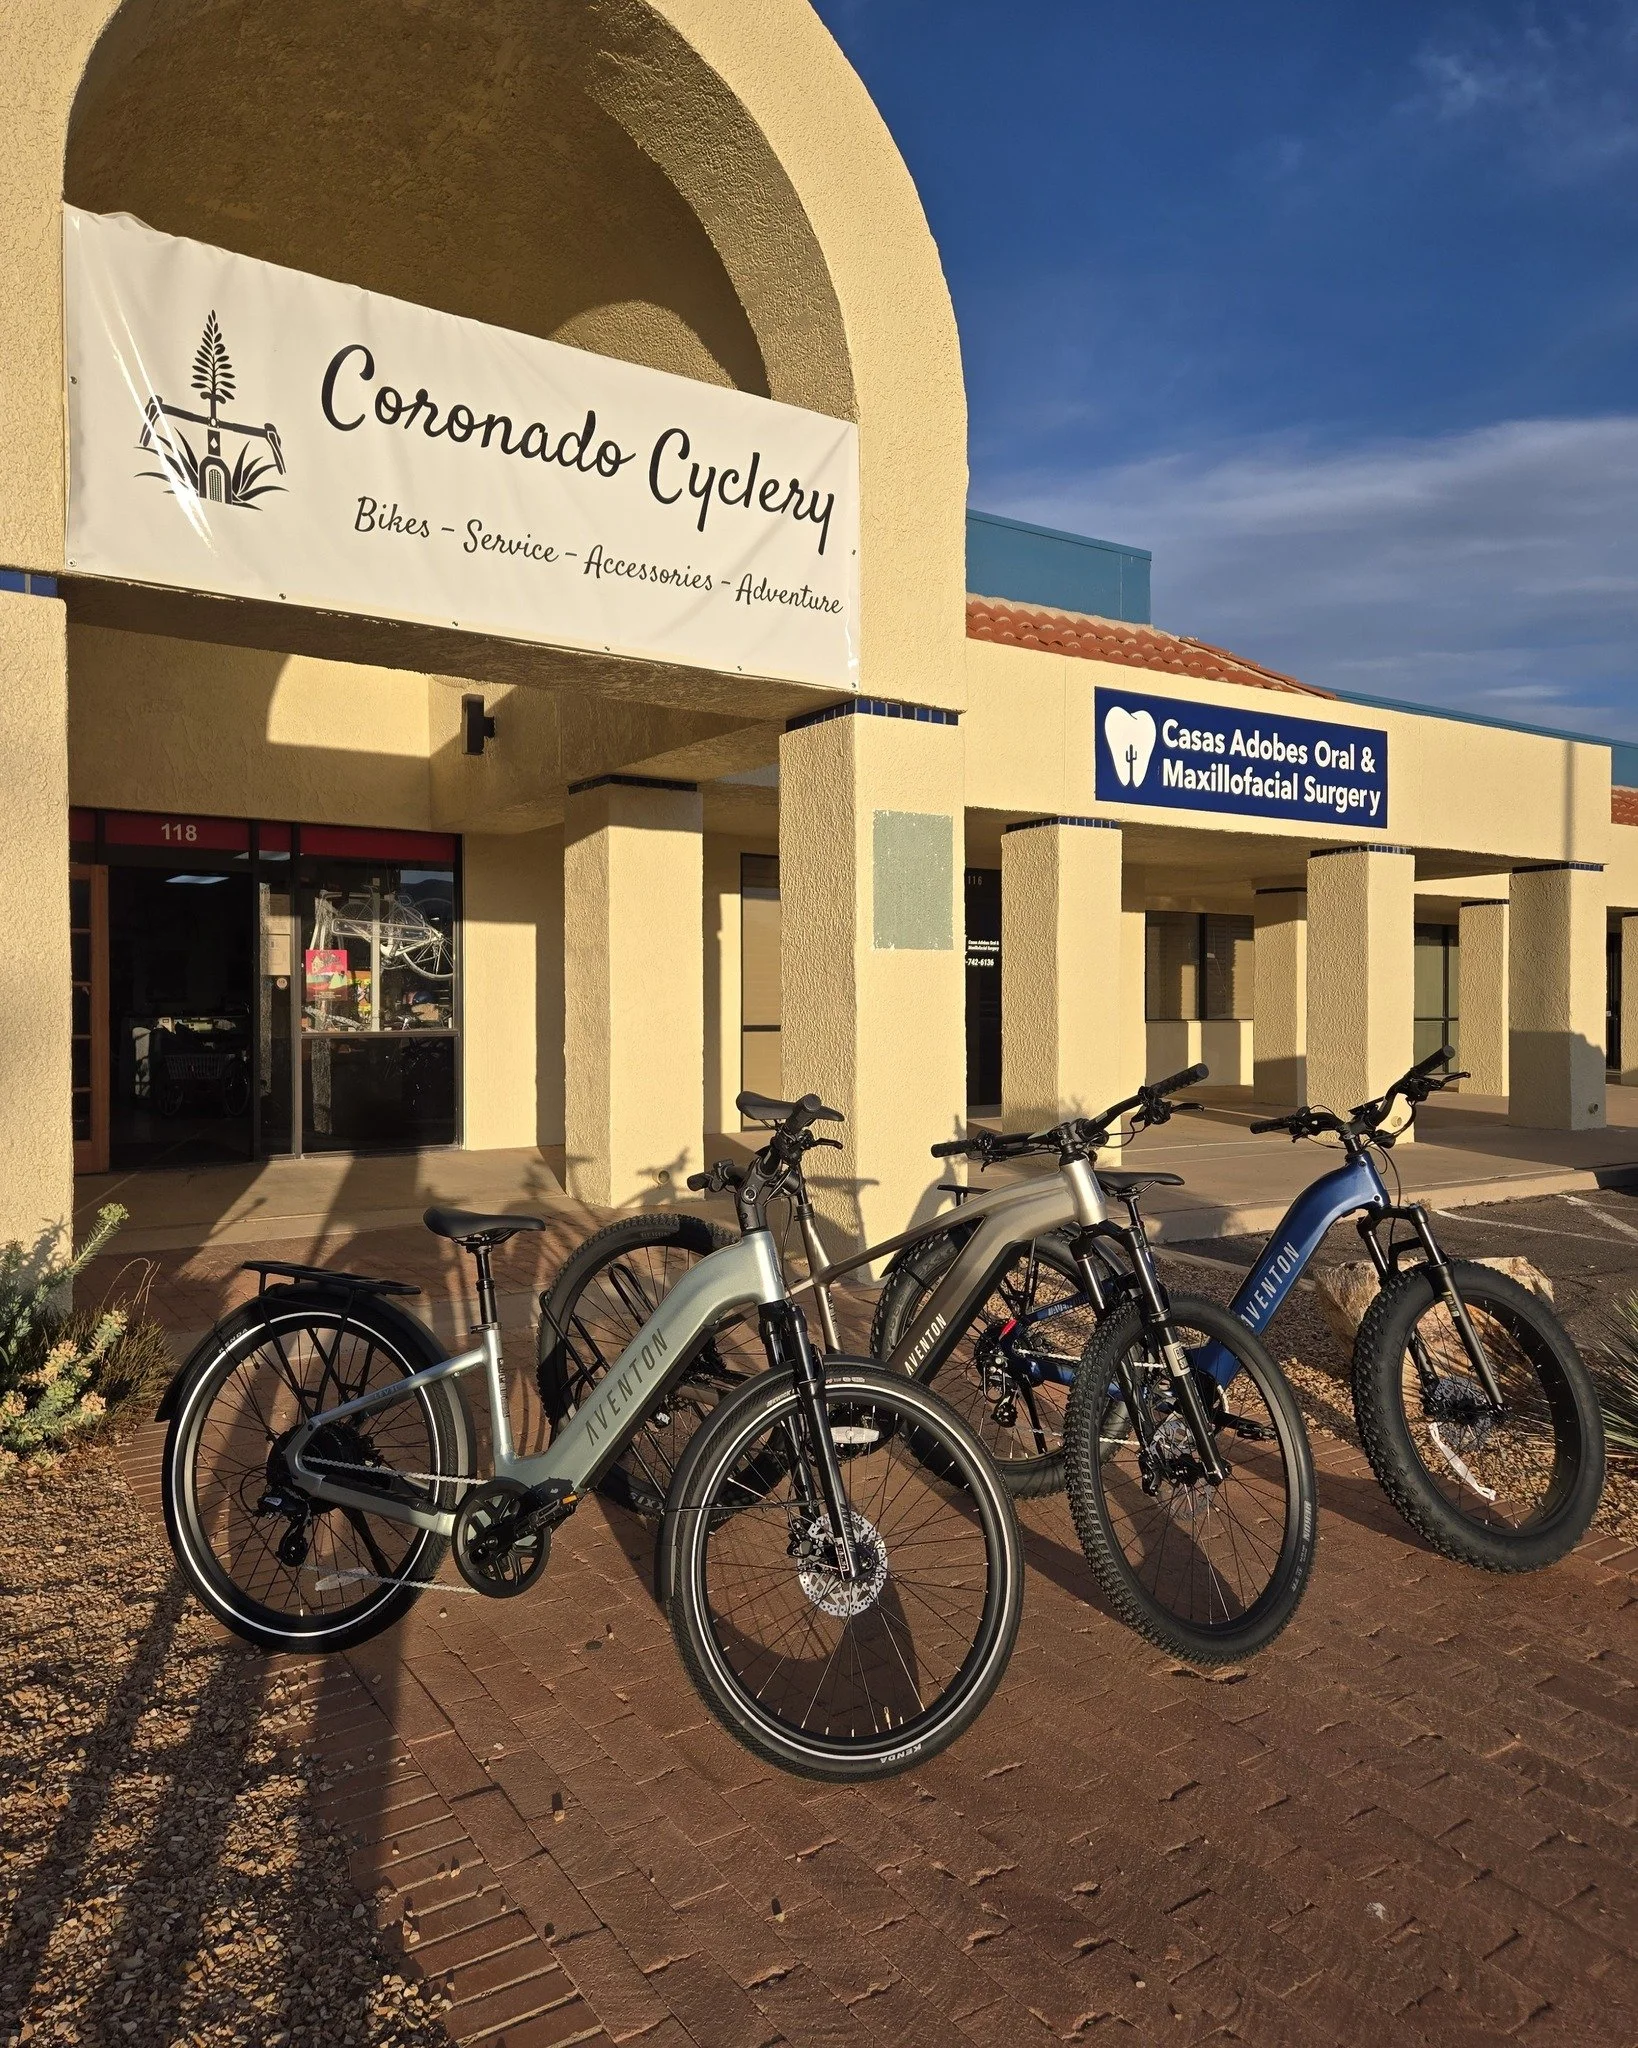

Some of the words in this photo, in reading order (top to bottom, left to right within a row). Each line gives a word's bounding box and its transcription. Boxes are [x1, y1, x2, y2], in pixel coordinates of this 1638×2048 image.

[321, 344, 636, 477] Coronado
[649, 428, 835, 555] Cyclery
[354, 496, 430, 538] Bikes
[463, 519, 559, 562] Service
[583, 545, 713, 590] Accessories
[735, 573, 844, 614] Adventure
[1162, 719, 1225, 754] Casas
[1229, 729, 1308, 765] Adobes
[1314, 741, 1355, 771] Oral
[1360, 747, 1376, 773] &
[1162, 759, 1298, 801] Maxillofacial
[1304, 775, 1381, 816] Surgery
[161, 823, 197, 842] 118
[967, 875, 983, 886] 116
[965, 958, 994, 966] -742-6136
[904, 1313, 947, 1376] AVENTON
[585, 1328, 668, 1446] AVENTON
[880, 1743, 922, 1764] KENDA
